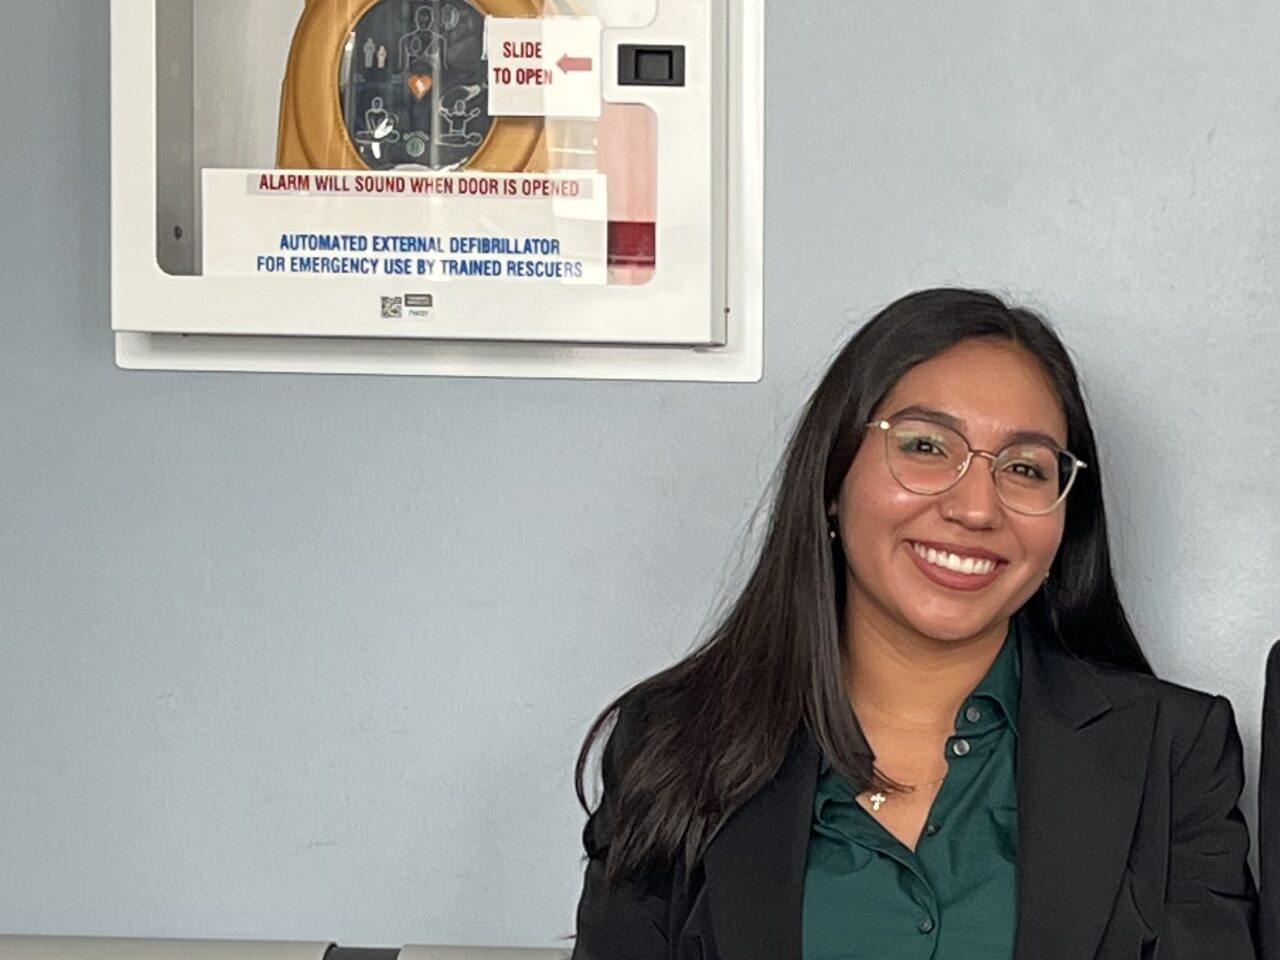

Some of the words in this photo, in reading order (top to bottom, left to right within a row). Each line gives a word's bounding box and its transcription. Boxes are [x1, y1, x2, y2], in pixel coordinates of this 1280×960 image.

[503, 41, 542, 58] SLIDE
[493, 67, 511, 85] TO
[516, 68, 553, 85] OPEN
[259, 174, 310, 190] ALARM
[315, 175, 350, 191] WILL
[355, 176, 405, 193] SOUND
[410, 177, 453, 194] WHEN
[458, 178, 498, 195] DOOR
[503, 179, 517, 195] IS
[522, 179, 580, 197] OPENED
[280, 234, 367, 251] AUTOMATED
[373, 236, 444, 253] EXTERNAL
[450, 237, 560, 255] DEFIBRILLATOR
[257, 256, 285, 272] FOR
[290, 257, 379, 274] EMERGENCY
[384, 258, 412, 275] USE
[417, 259, 435, 275] BY
[440, 260, 501, 276] TRAINED
[507, 261, 583, 278] RESCUERS
